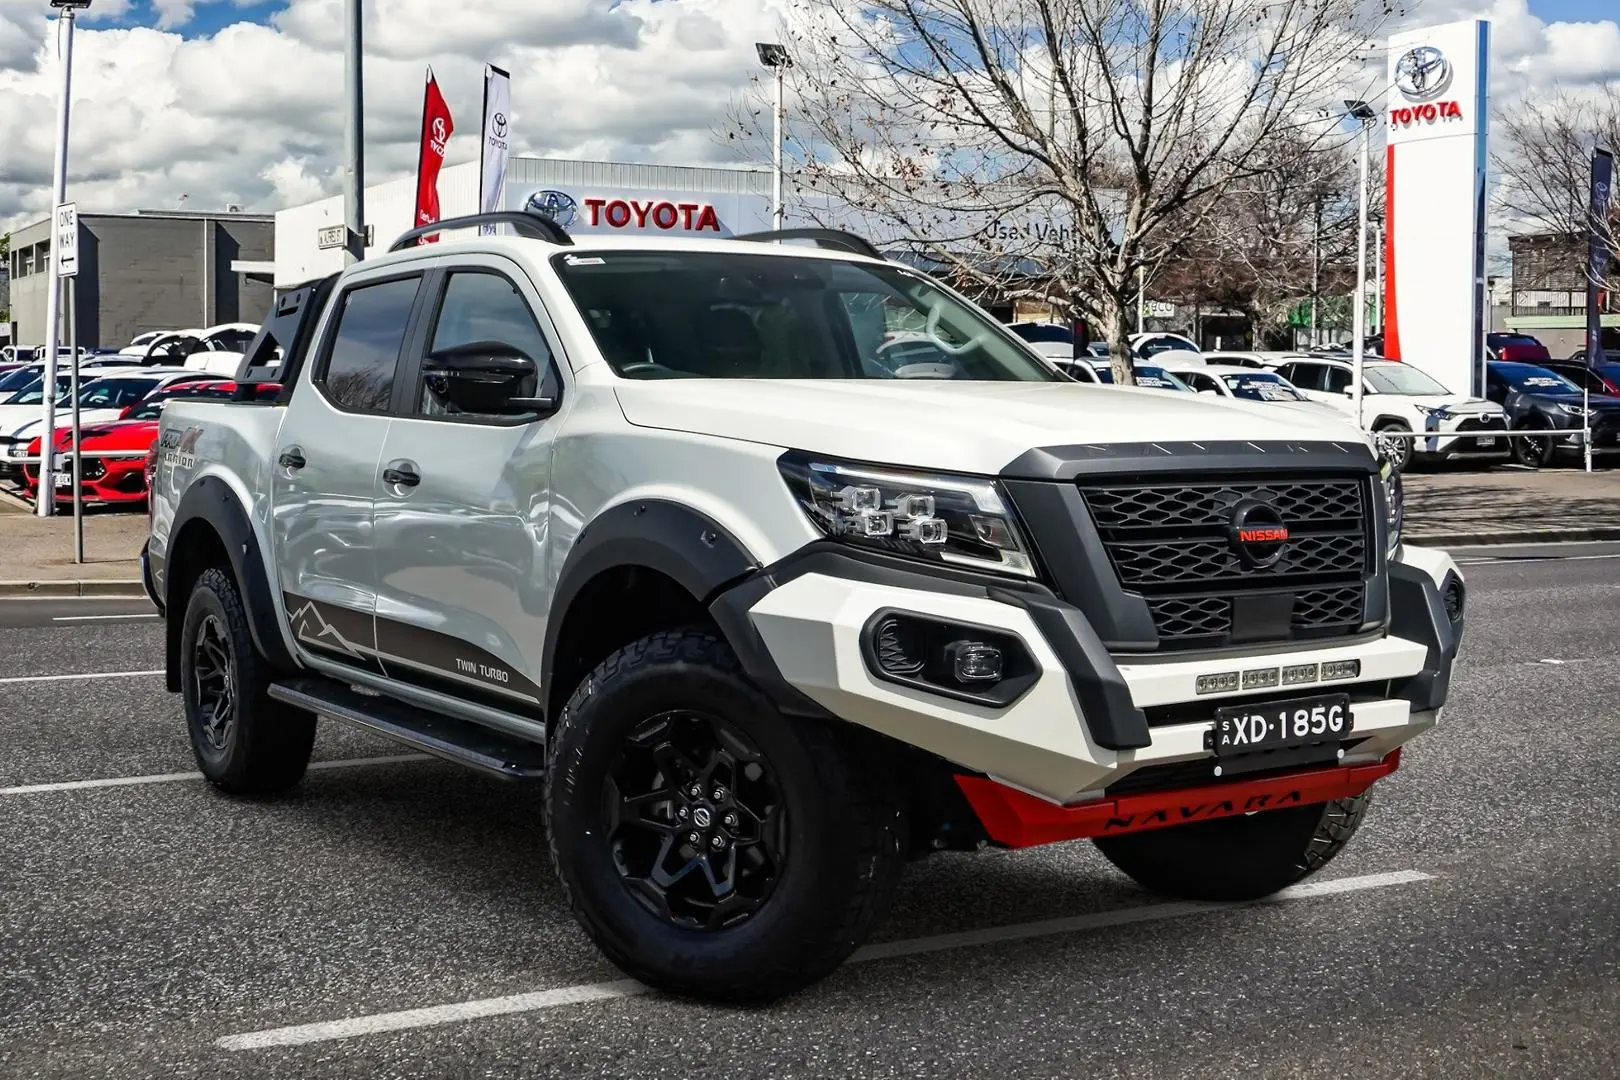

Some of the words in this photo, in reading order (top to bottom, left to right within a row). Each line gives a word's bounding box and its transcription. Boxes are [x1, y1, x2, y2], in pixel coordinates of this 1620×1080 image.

[1389, 101, 1462, 125] TOYOTA
[488, 136, 508, 151] TOYOTA
[60, 209, 74, 228] ONE
[584, 198, 720, 232] TOYOTA
[59, 231, 75, 249] WAY
[985, 220, 1030, 241] Used
[1240, 528, 1288, 541] NISSAN
[455, 658, 477, 674] TWIN
[479, 664, 508, 683] TURBO
[1104, 790, 1300, 830] NAVARA
